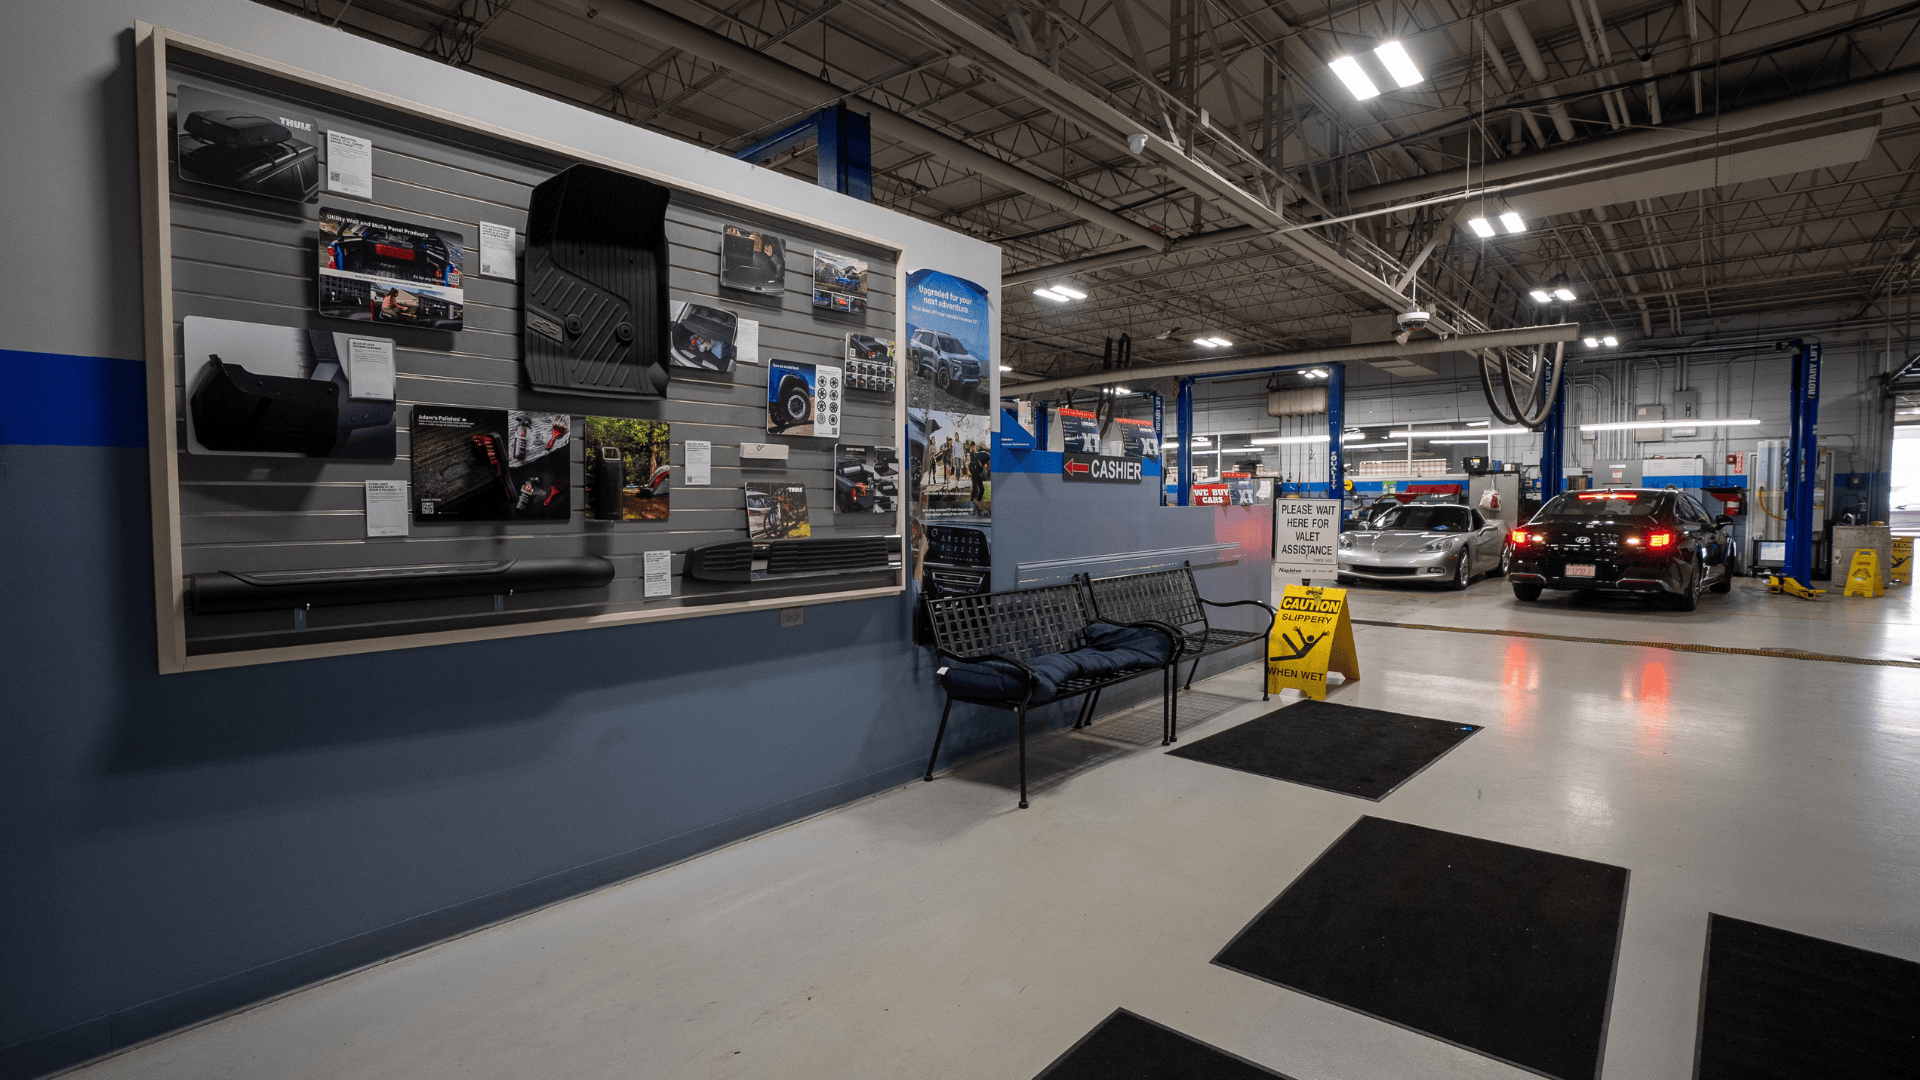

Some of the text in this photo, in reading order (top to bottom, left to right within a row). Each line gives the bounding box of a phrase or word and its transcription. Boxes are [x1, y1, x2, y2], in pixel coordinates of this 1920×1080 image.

[279, 116, 311, 131] THULE
[327, 214, 345, 222] Utility
[404, 229, 428, 238] Products
[919, 285, 972, 305] Upgraded for your
[924, 297, 968, 313] next adventure
[1808, 363, 1817, 395] ROTARY
[1082, 433, 1100, 452] XT
[1140, 438, 1159, 456] XT
[1091, 459, 1141, 480] CASHIER
[1238, 490, 1253, 503] XT
[1282, 504, 1336, 515] PLEASE WAIT
[1287, 518, 1329, 528] HERE FOR
[1296, 532, 1320, 541] VALET
[1282, 545, 1332, 555] ASSISTANCE
[1282, 598, 1340, 613] CAUTION
[1282, 614, 1332, 624] SLIPPERY
[1268, 667, 1324, 681] WHEN WET
